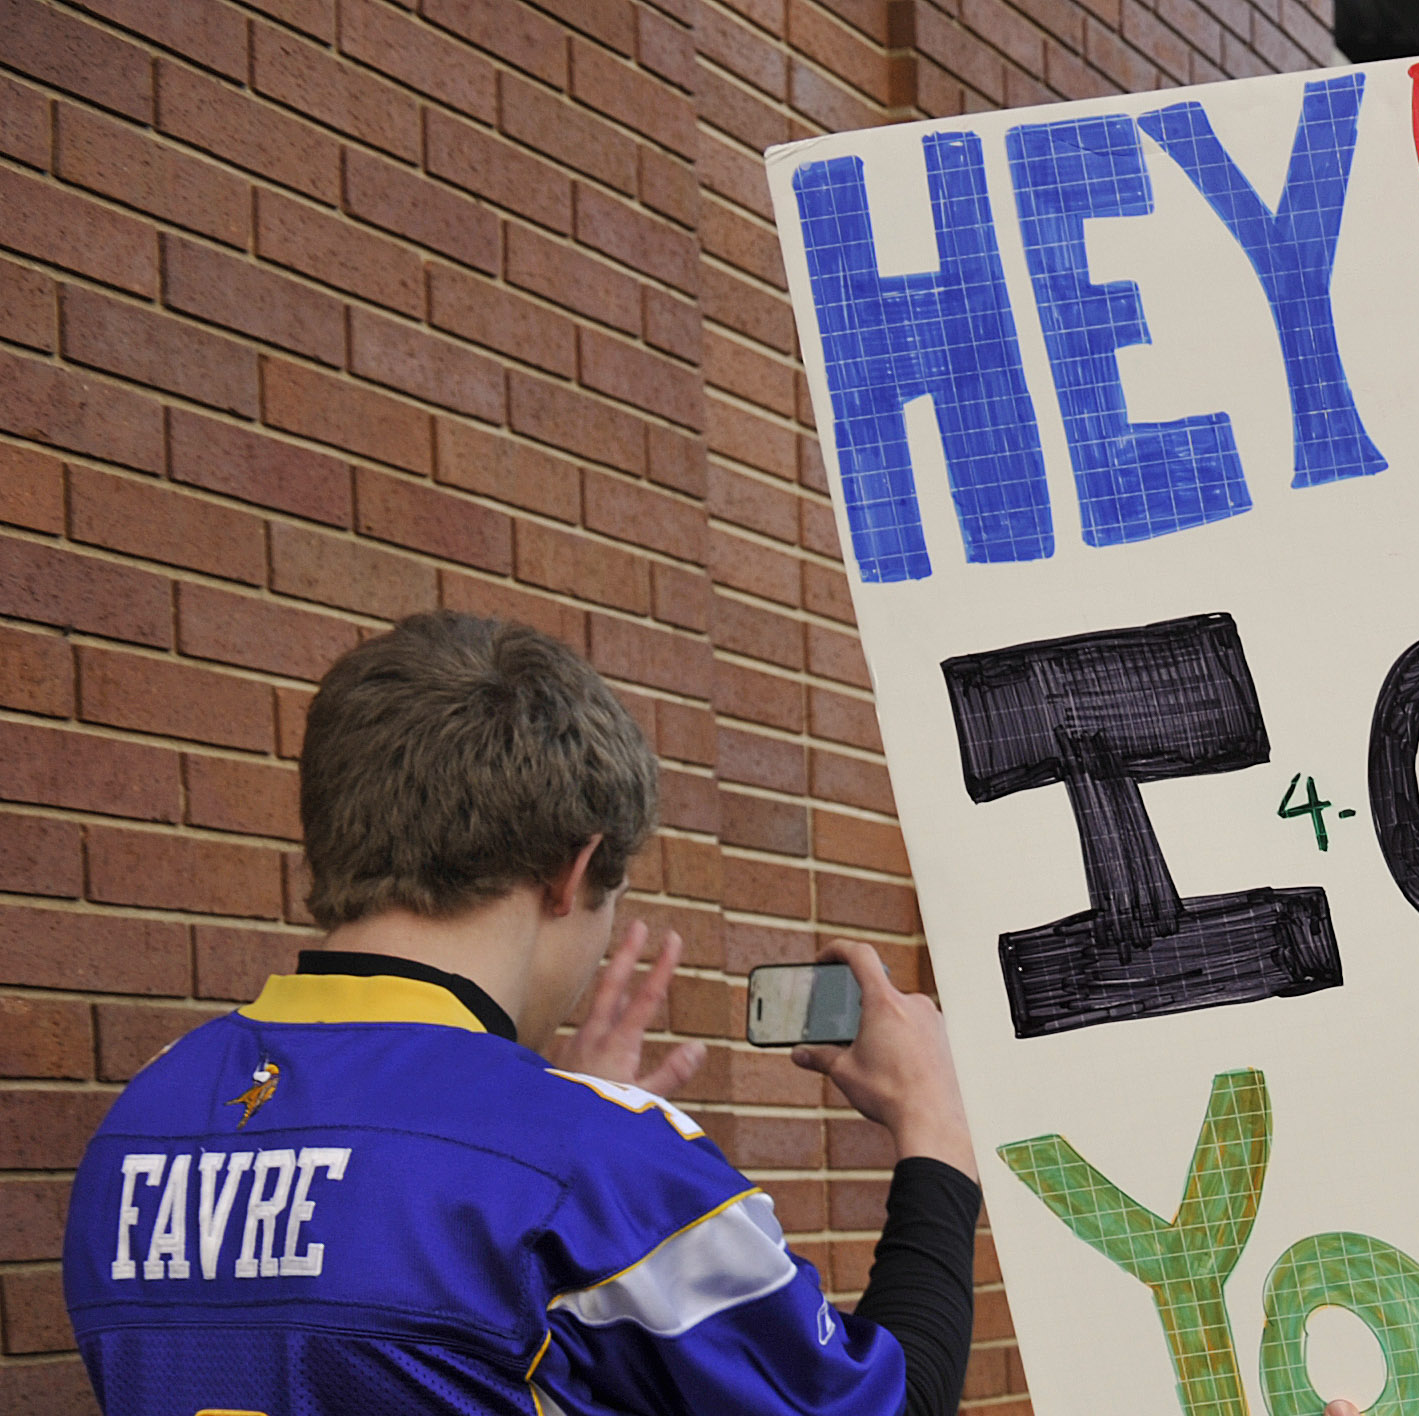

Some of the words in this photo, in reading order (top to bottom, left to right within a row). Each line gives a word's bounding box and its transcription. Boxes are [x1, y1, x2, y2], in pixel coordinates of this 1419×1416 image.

[791, 72, 1389, 585] HEY
[939, 612, 1344, 1040] I
[111, 1146, 352, 1280] FAVRE
